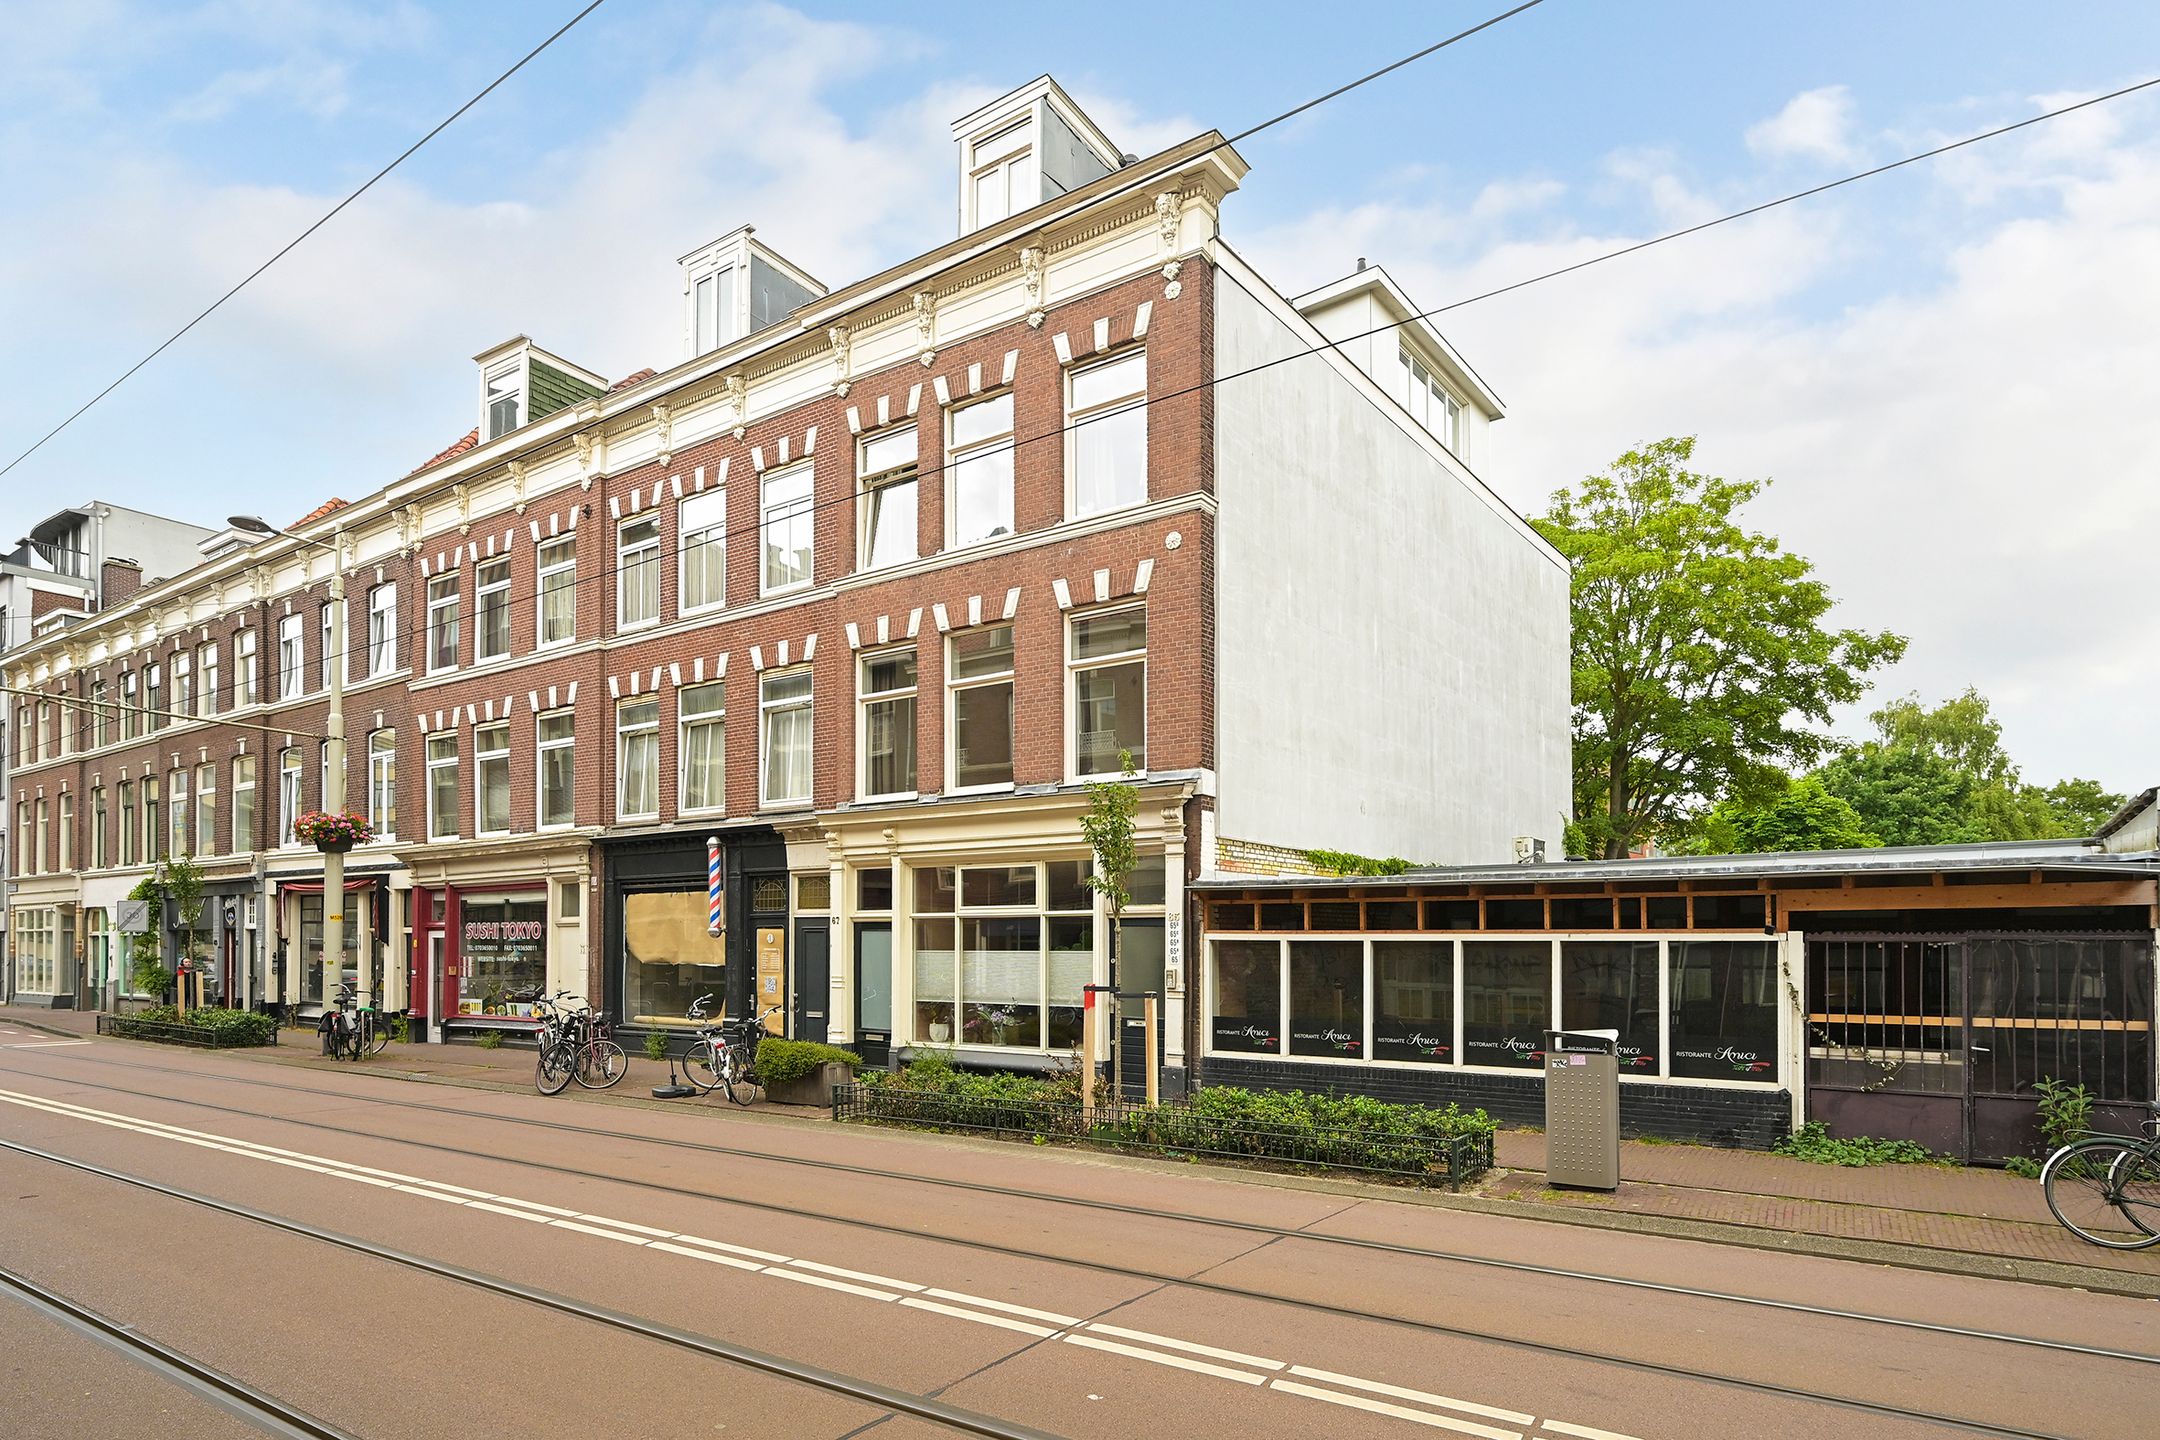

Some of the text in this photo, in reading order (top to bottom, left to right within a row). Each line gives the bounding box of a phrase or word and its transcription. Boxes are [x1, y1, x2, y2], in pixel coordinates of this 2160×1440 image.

[831, 917, 840, 925] 67
[465, 921, 542, 939] SUSHI TOKYO
